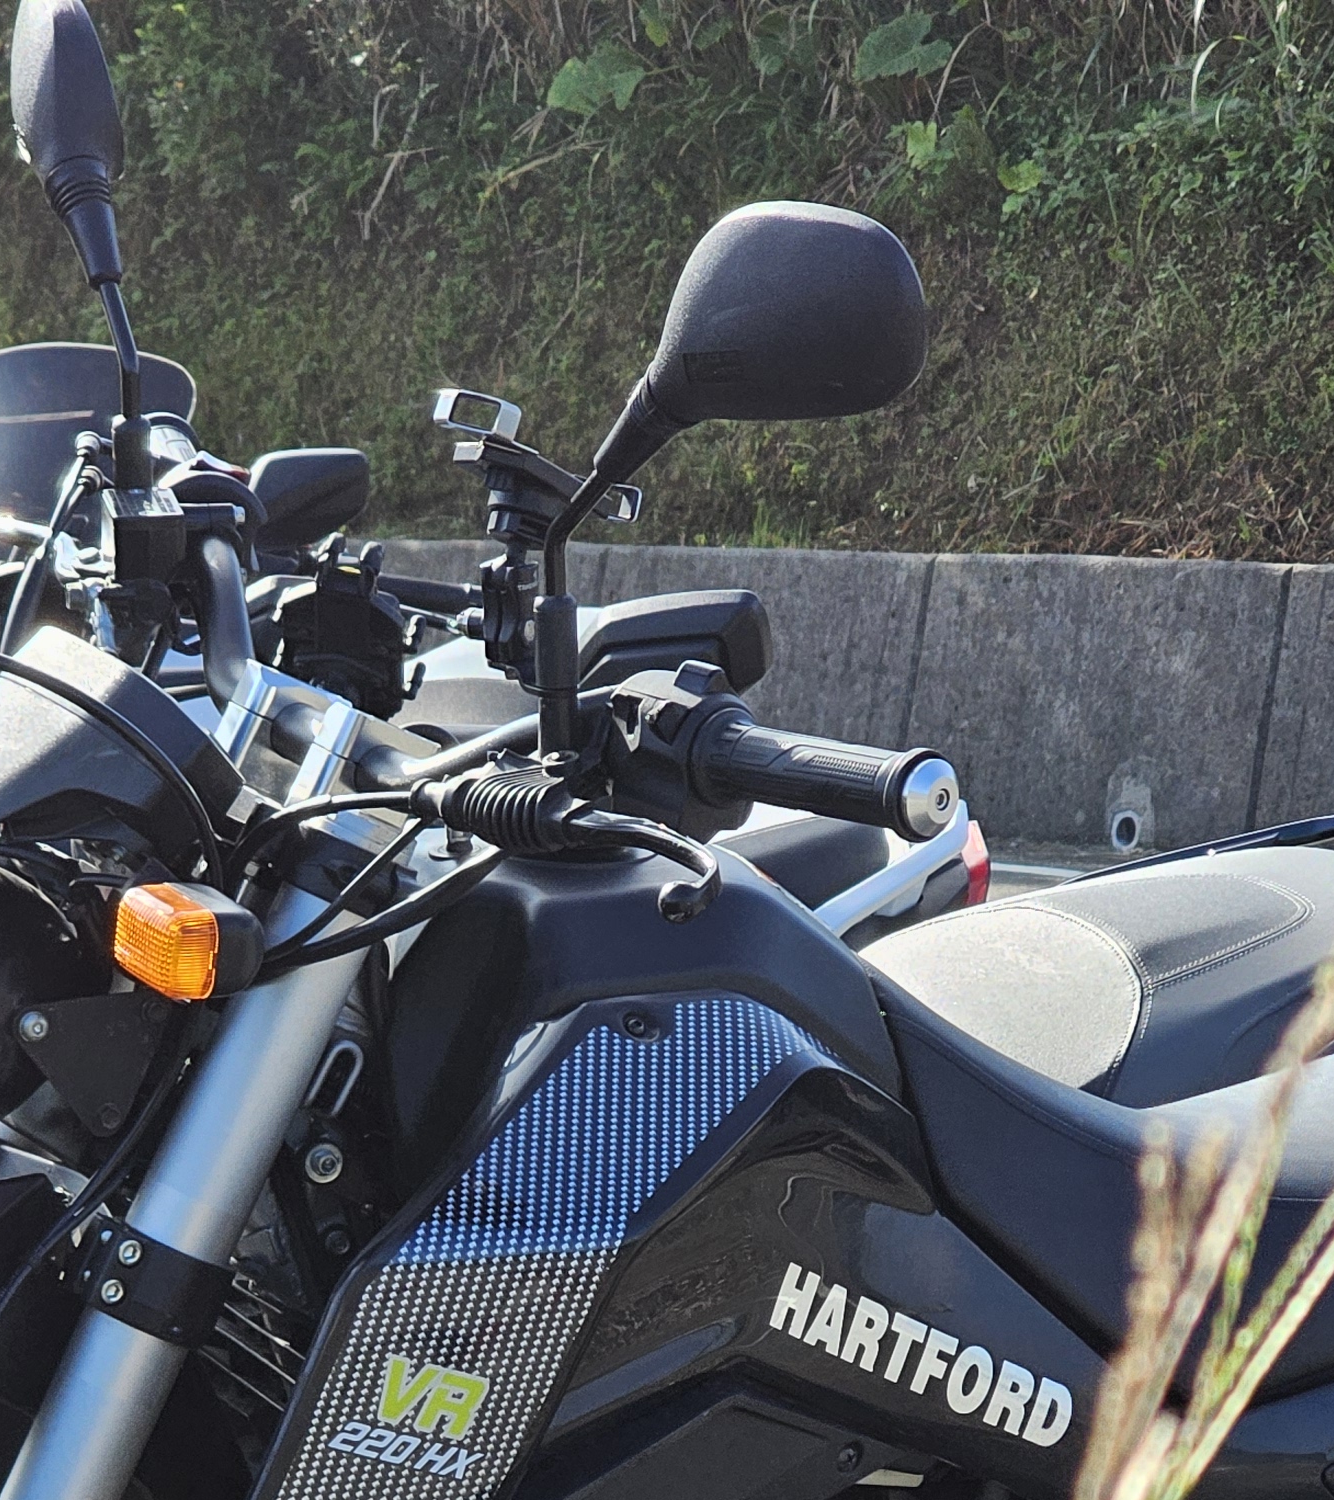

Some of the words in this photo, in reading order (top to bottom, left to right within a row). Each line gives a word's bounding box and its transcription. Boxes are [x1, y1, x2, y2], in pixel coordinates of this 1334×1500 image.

[377, 1354, 490, 1441] VR
[769, 1262, 1073, 1448] HARTFORD
[328, 1421, 421, 1465] 220
[414, 1443, 484, 1480] HX
